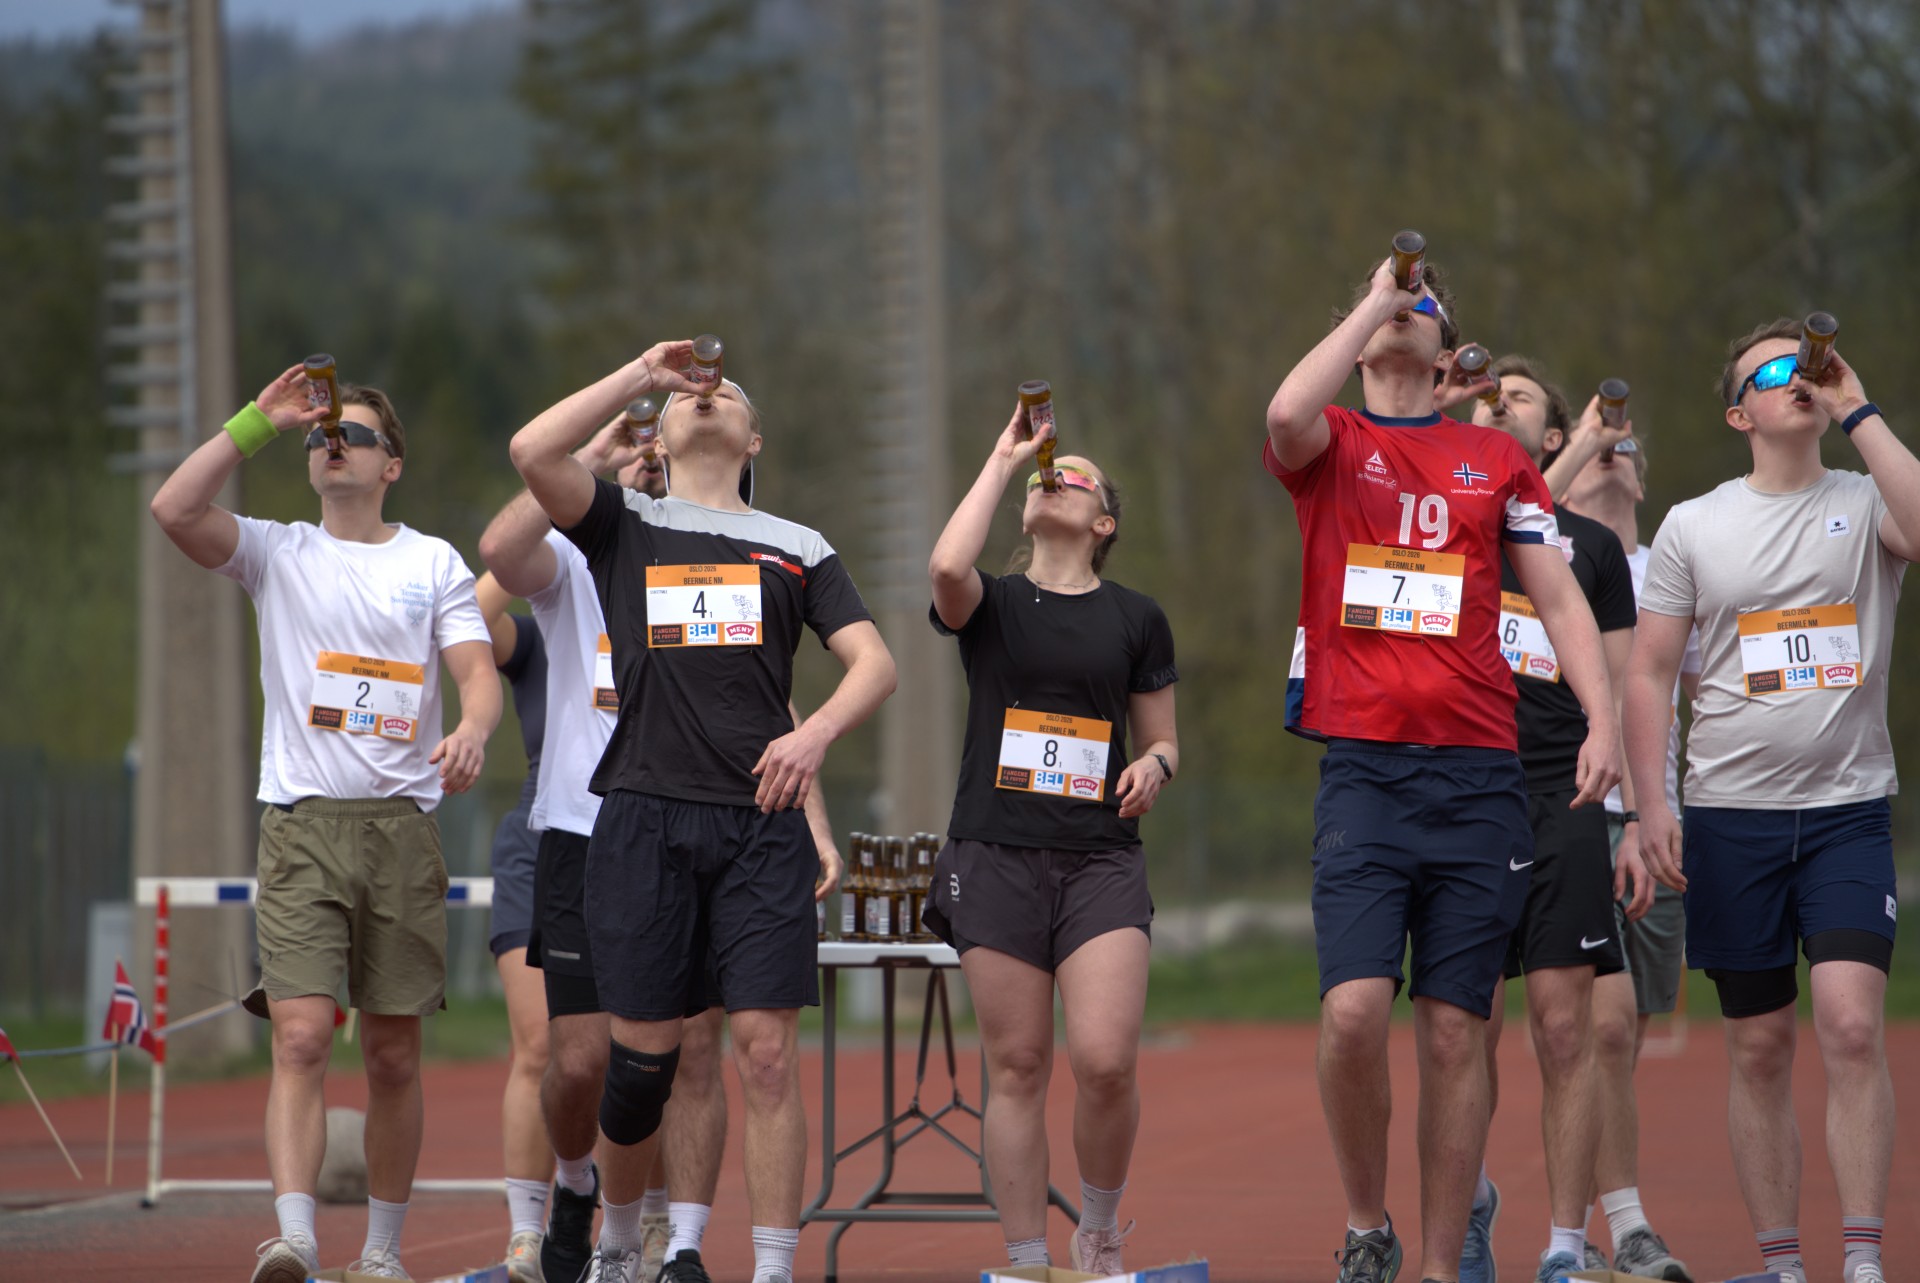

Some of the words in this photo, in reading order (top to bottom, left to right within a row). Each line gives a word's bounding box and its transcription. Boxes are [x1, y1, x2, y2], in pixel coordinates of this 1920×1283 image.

[1365, 464, 1387, 475] SELECT
[1399, 492, 1448, 549] 19
[1392, 549, 1406, 557] OSLO
[1407, 550, 1420, 558] 2026
[689, 565, 702, 573] OSLO
[1385, 560, 1414, 570] BEERMILE
[1415, 563, 1425, 571] NM
[407, 582, 428, 591] Asker
[683, 577, 712, 585] BEERMILE
[400, 589, 426, 598] Tennis
[1392, 575, 1406, 603] 7
[692, 591, 707, 619] 4
[1384, 609, 1412, 622] BEL
[1425, 616, 1449, 625] MENY
[688, 624, 717, 636] BEL
[1777, 620, 1806, 630] BEERMILE
[1808, 619, 1818, 627] NM
[1504, 618, 1519, 645] 6
[1783, 634, 1810, 663] 10
[352, 666, 379, 678] BEERMILE
[380, 670, 390, 679] NM
[1786, 667, 1815, 681] BEL
[1829, 668, 1851, 676] MENY
[355, 681, 370, 708] 2
[349, 711, 376, 725] BEL
[1046, 714, 1060, 722] OSLO
[387, 721, 408, 731] MENY
[1039, 725, 1067, 735] BEERMILE
[1043, 739, 1058, 767] 8
[1036, 772, 1064, 784] BEL
[1076, 781, 1096, 789] MENY
